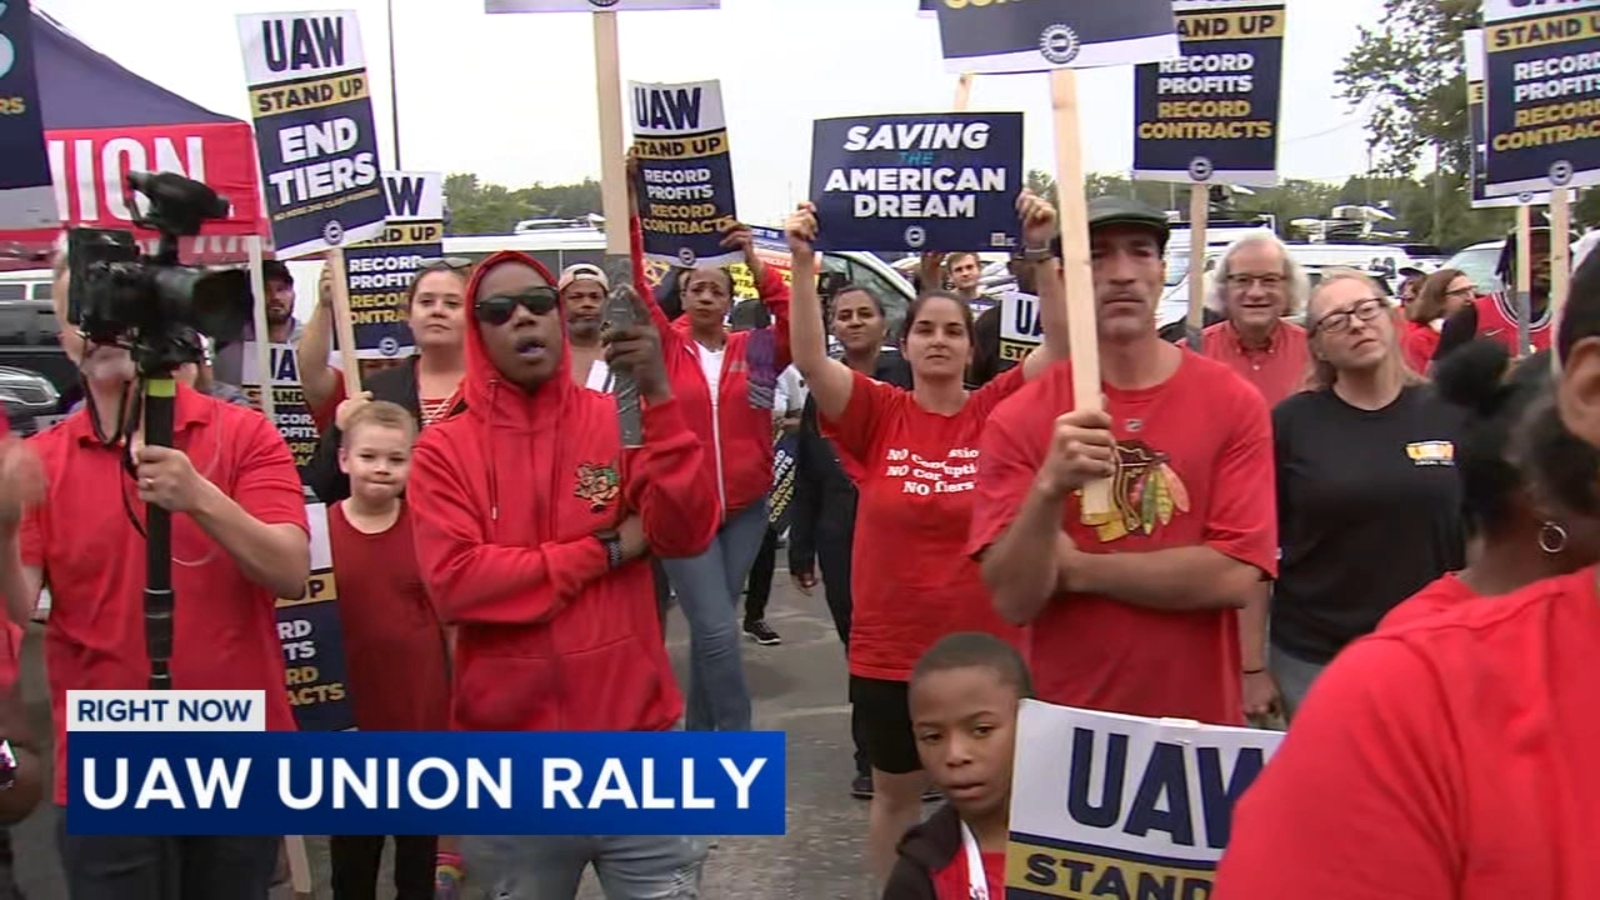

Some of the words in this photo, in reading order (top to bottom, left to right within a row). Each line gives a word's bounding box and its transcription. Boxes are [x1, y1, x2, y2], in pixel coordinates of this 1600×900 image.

[1239, 14, 1276, 34] UP
[1495, 17, 1582, 47] STAND
[261, 16, 344, 72] UAW
[1159, 53, 1254, 73] RECORD
[1158, 75, 1254, 94] PROFITS
[257, 83, 334, 112] STAND
[338, 78, 364, 98] UP
[634, 86, 701, 130] UAW
[1158, 100, 1251, 118] RECORD
[843, 122, 991, 152] SAVING
[1139, 120, 1273, 139] CONTRACTS
[278, 117, 358, 164] END
[691, 137, 721, 153] UP
[899, 151, 934, 165] THE
[269, 152, 377, 206] TIERS
[643, 168, 711, 184] RECORD
[823, 167, 1006, 192] AMERICAN
[646, 184, 715, 200] PROFITS
[650, 203, 716, 218] RECORD
[853, 193, 976, 219] DREAM
[410, 227, 436, 241] UP
[643, 216, 732, 235] CONTRACT
[886, 448, 909, 461] NO
[886, 464, 910, 477] NO
[902, 480, 930, 496] NO
[1067, 726, 1264, 850] UAW
